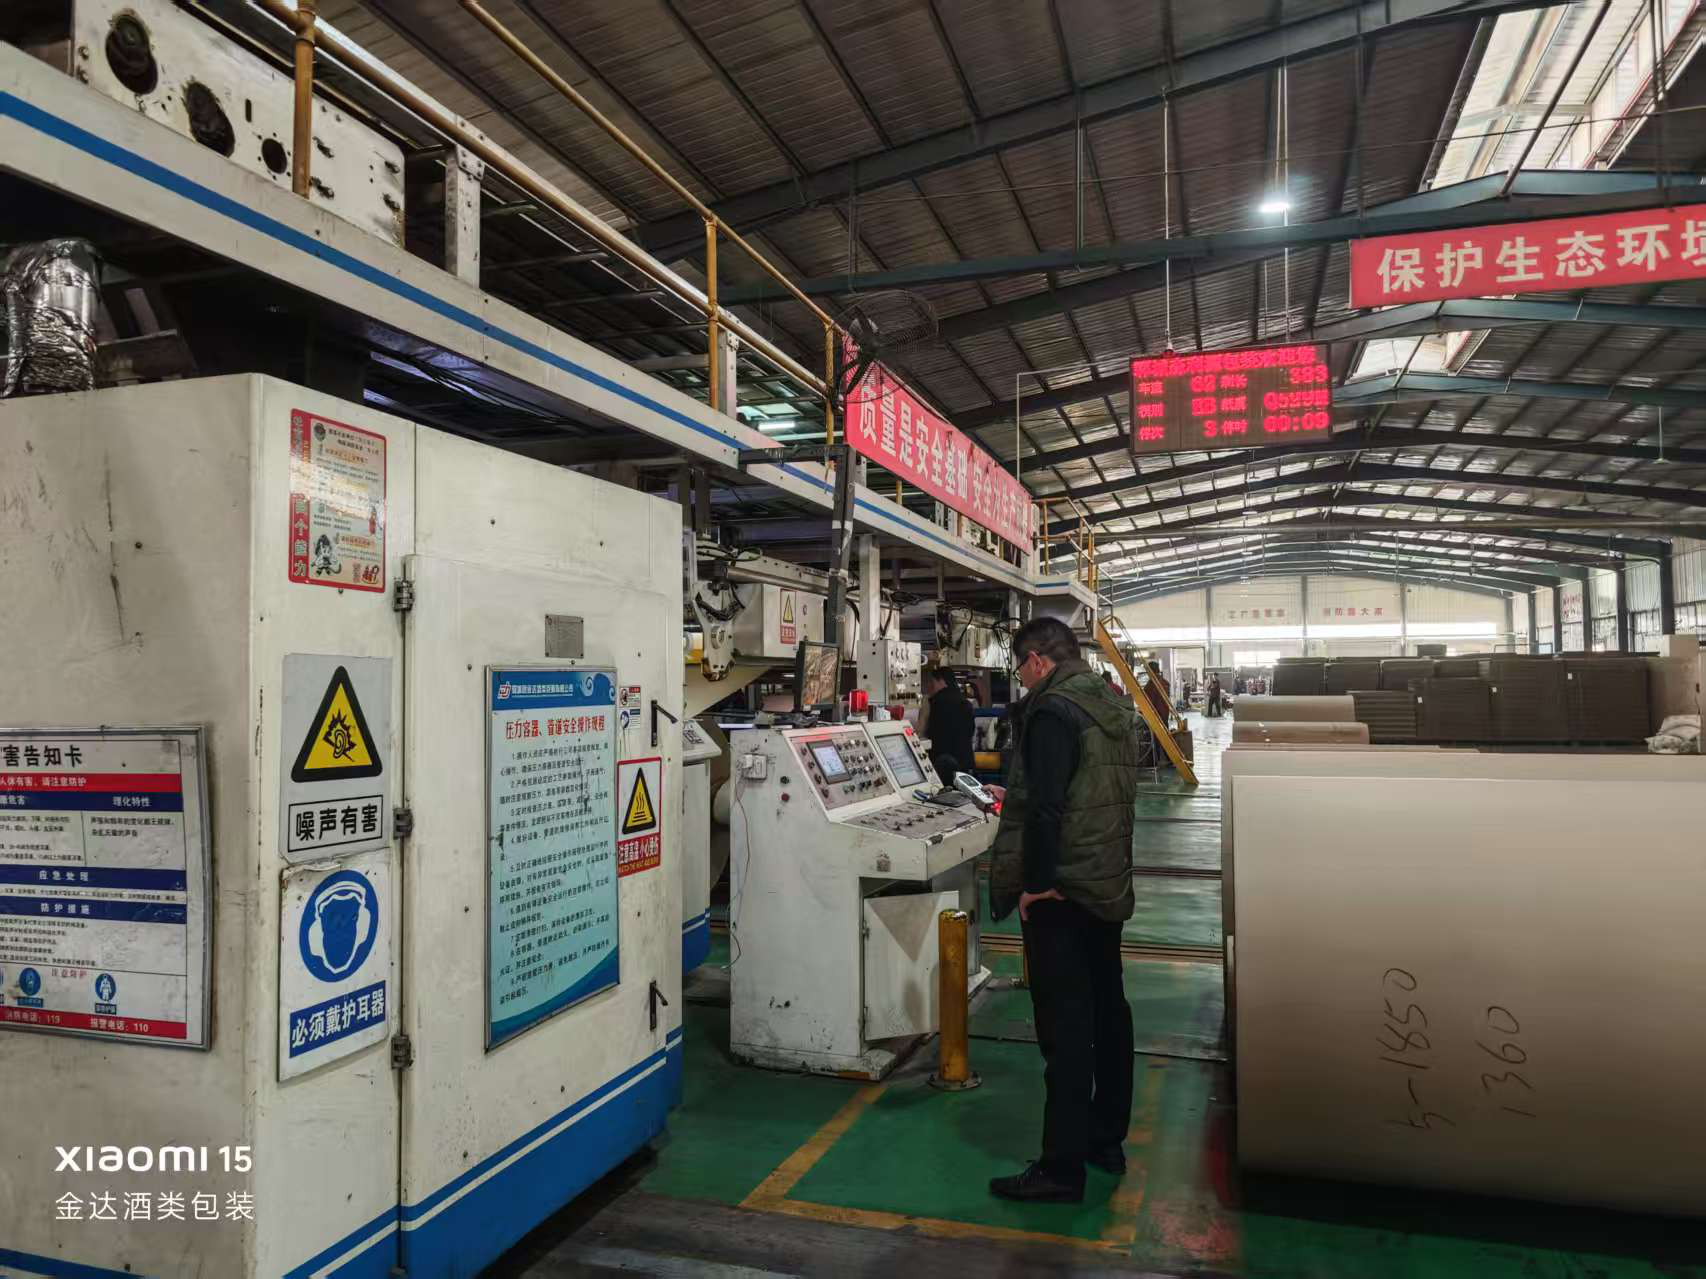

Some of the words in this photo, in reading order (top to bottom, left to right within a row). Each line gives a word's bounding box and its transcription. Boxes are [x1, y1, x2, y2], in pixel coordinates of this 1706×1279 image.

[505, 715, 605, 739] 压力容器、管道安全操作规程
[0, 743, 83, 768] 害告知卡
[112, 797, 151, 807] 理化特性
[296, 803, 378, 841] 噪声有害
[39, 870, 89, 882] 应急处理
[40, 902, 91, 915] 防护措施
[292, 988, 385, 1049] 必须戴护耳器
